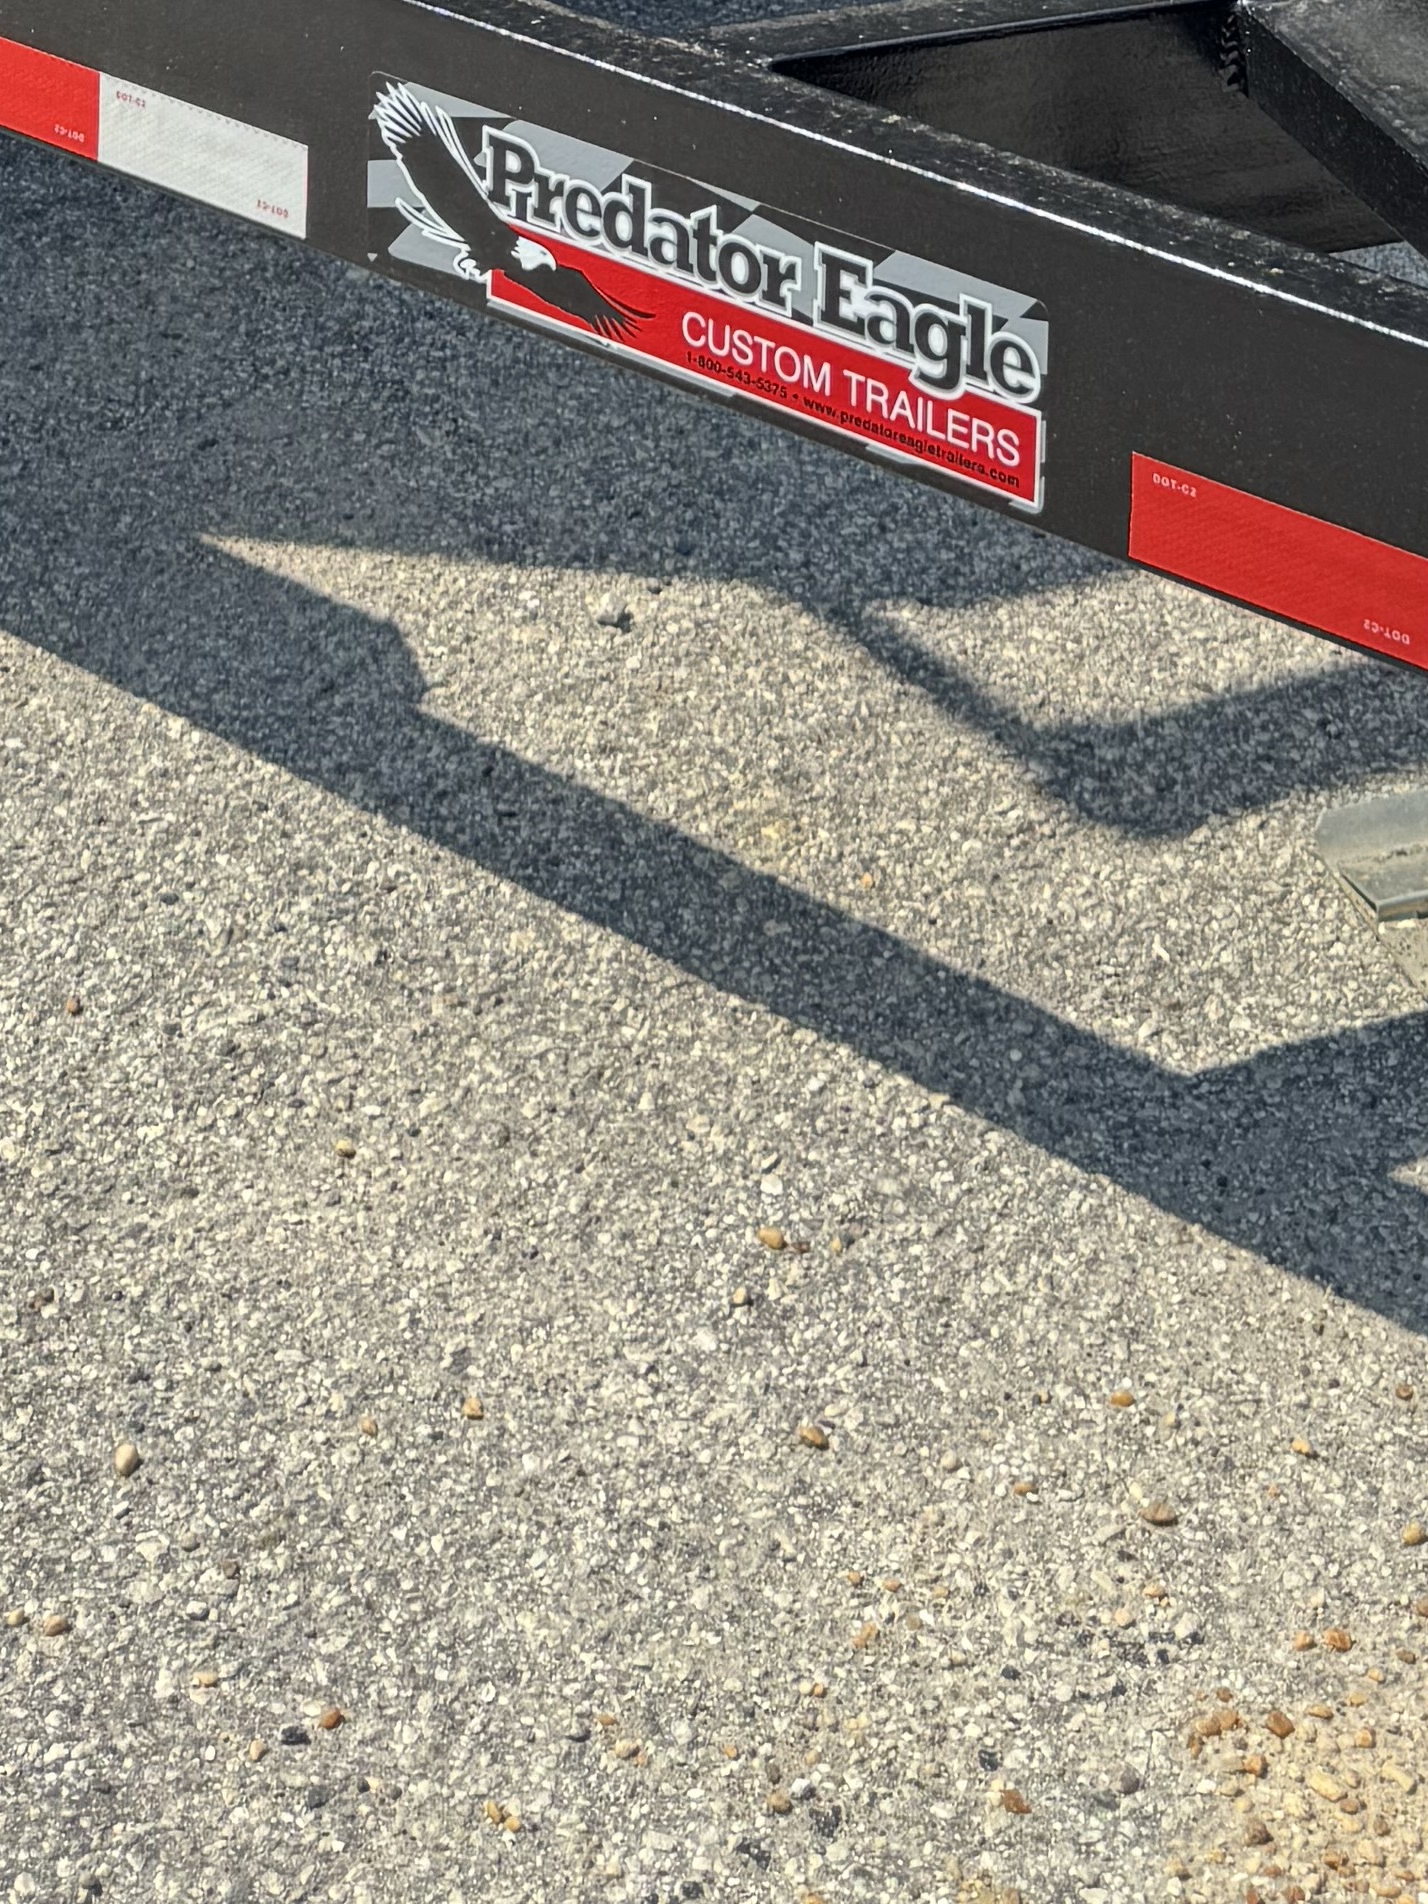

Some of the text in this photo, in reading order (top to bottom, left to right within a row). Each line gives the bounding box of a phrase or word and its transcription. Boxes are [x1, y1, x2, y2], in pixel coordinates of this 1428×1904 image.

[116, 90, 146, 108] DOT-C2
[55, 123, 85, 143] DOT-C2
[257, 199, 289, 219] DOT-C2
[481, 125, 1043, 404] Predator Eagle
[682, 311, 1020, 467] CUSTOM TRAILERS
[685, 351, 1020, 489] 1-800-543-5375 www.predatoreagletrailers.com
[1152, 472, 1198, 498] DOT-C2
[1363, 619, 1410, 645] DOT-C2
